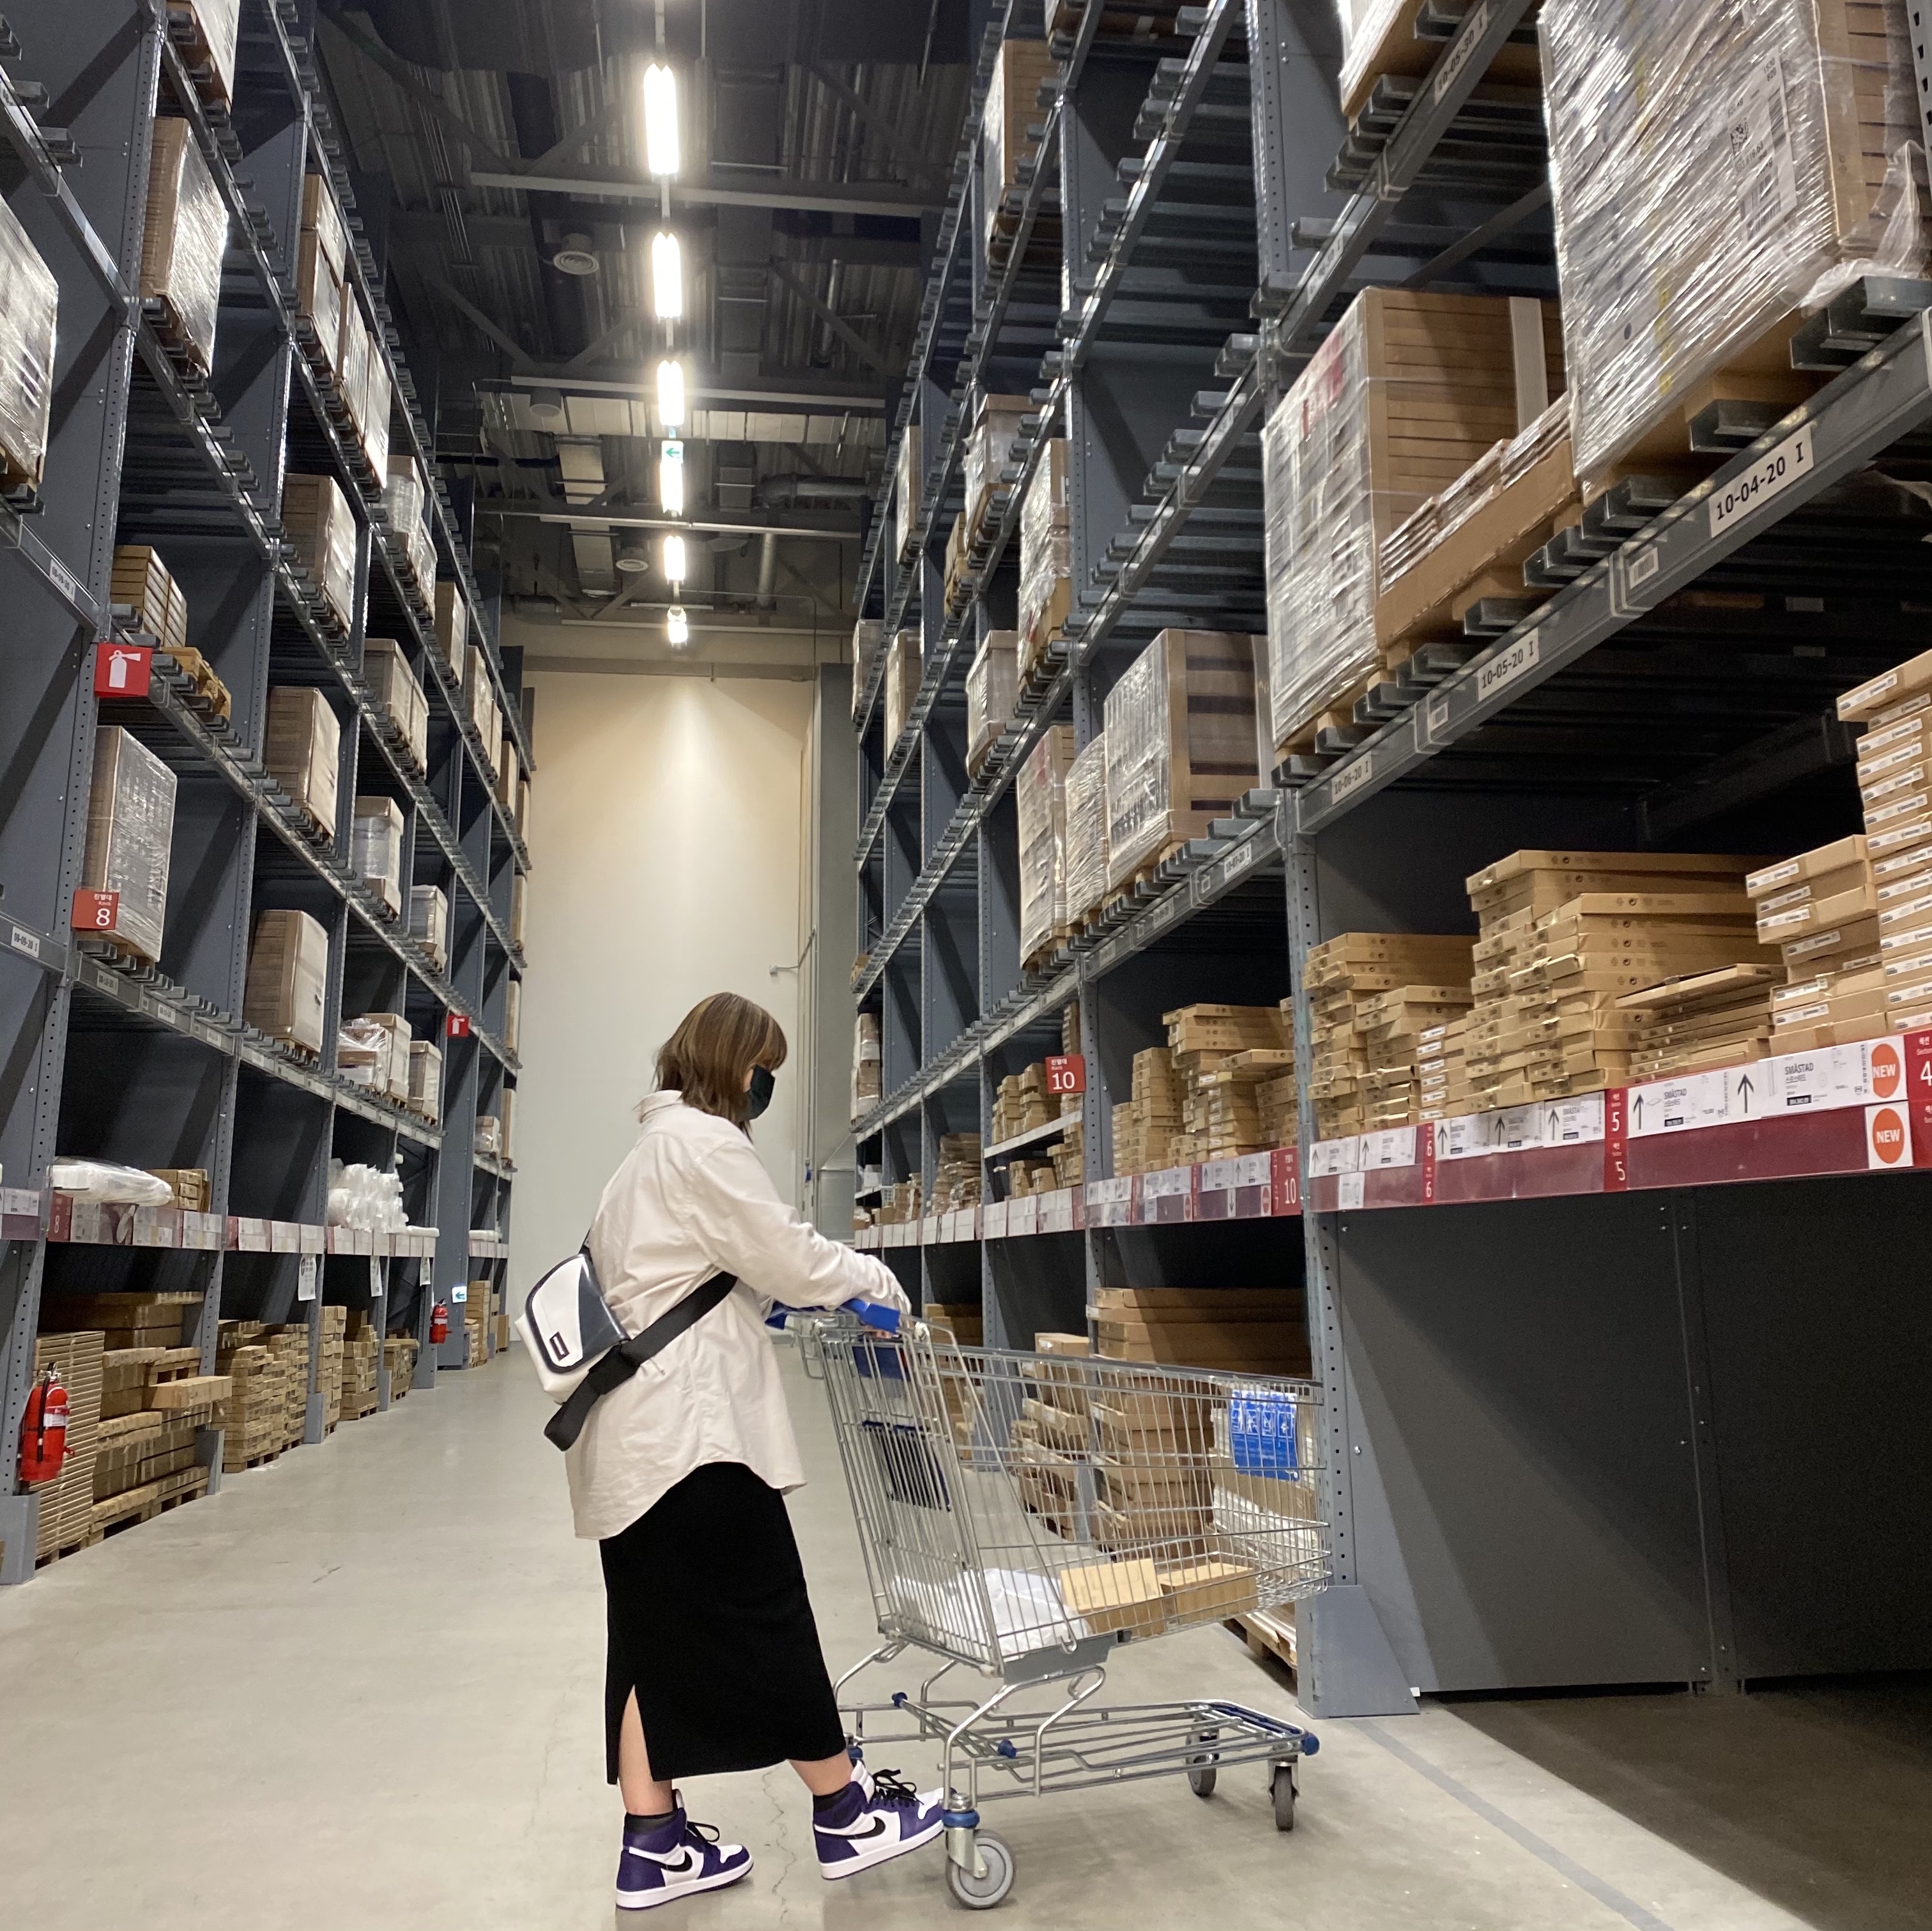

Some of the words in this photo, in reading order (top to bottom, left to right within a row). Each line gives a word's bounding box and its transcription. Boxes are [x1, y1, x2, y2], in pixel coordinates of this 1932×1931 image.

[1717, 456, 1786, 521] 10-04-20
[1796, 442, 1804, 463] I
[1482, 648, 1523, 689] 10-05-20
[1529, 641, 1534, 657] I
[1335, 765, 1361, 795] 10-06-20
[96, 908, 111, 926] 8
[1784, 1063, 1814, 1074] SMÅSTAD
[1873, 1064, 1896, 1078] NEW
[1920, 1060, 1932, 1086] 4
[1052, 1071, 1075, 1090] 10
[1612, 1111, 1620, 1131] 5
[1876, 1129, 1901, 1143] NEW
[1427, 1140, 1432, 1157] 6
[1615, 1161, 1625, 1181] 5
[1285, 1178, 1296, 1204] 10
[1426, 1181, 1432, 1198] 6
